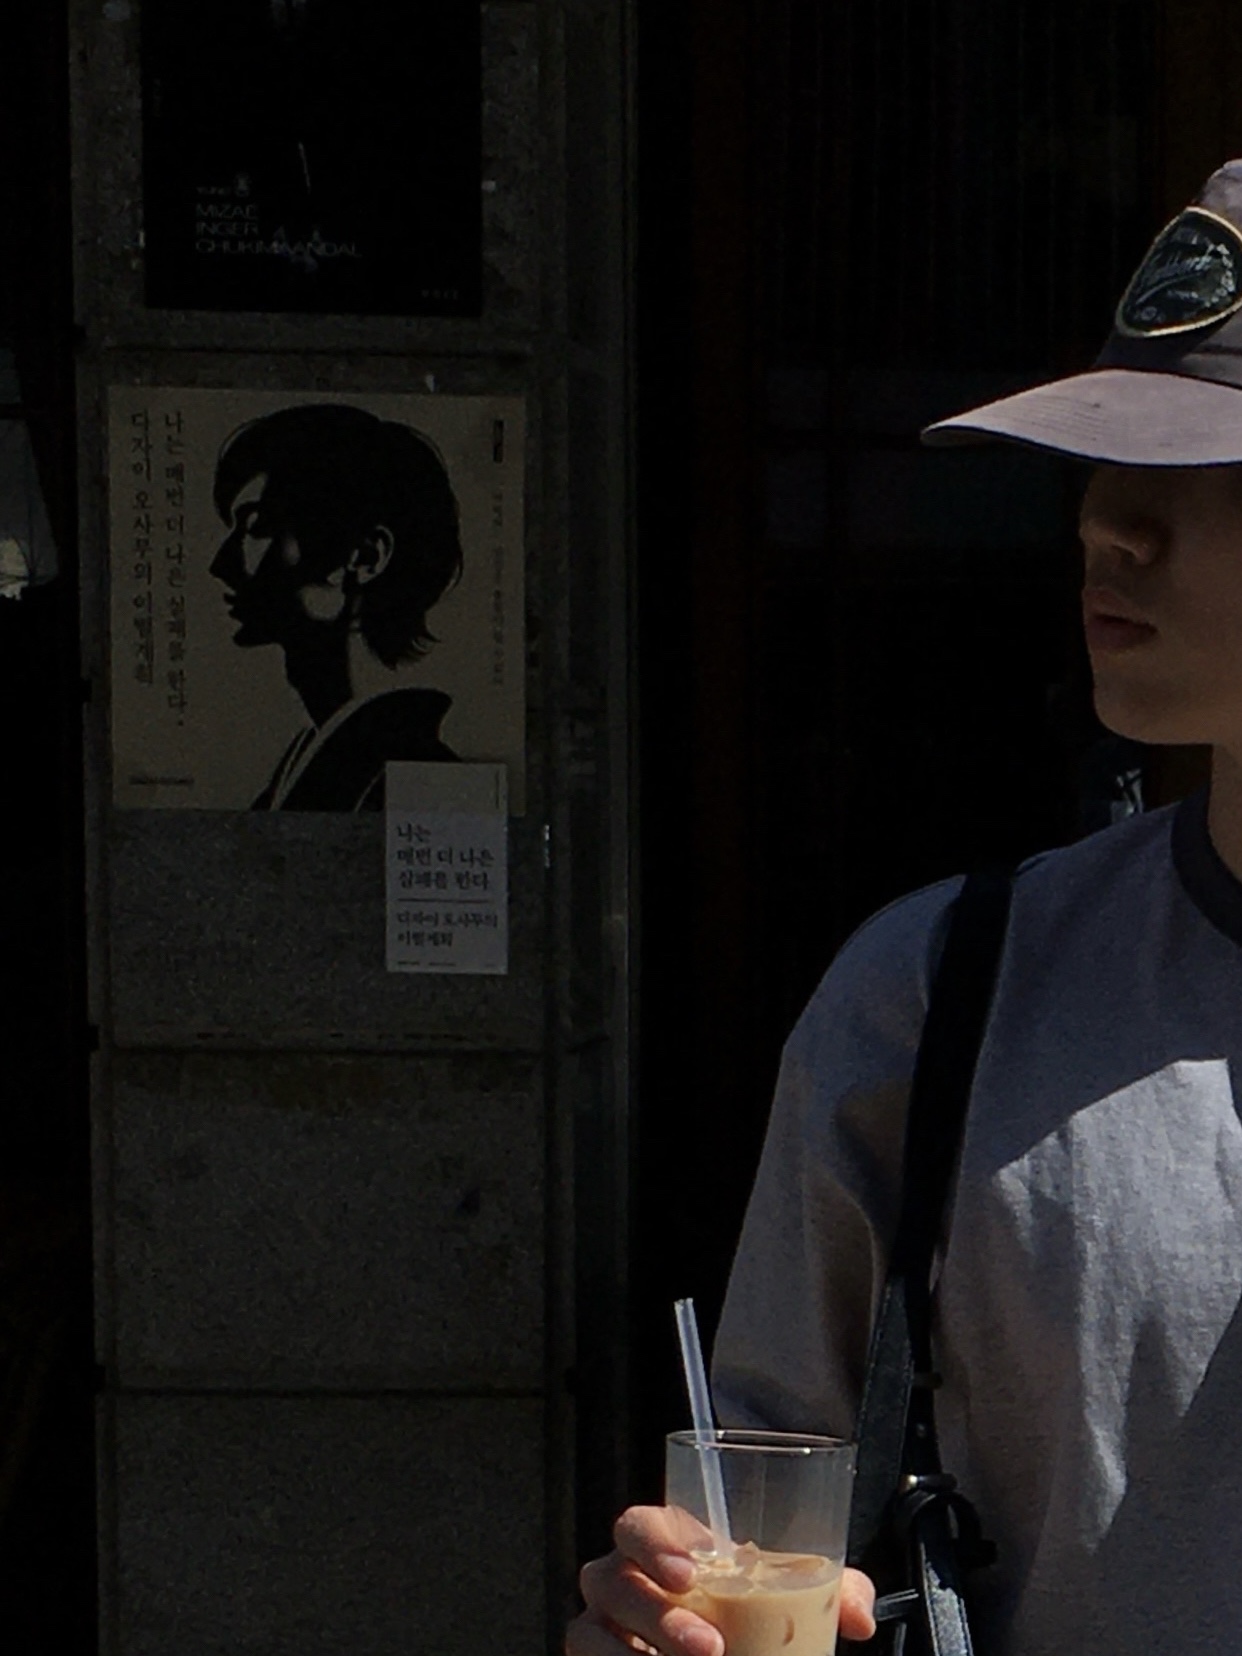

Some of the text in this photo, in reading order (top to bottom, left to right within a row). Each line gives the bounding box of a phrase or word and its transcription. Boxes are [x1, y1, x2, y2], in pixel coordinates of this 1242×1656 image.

[131, 408, 152, 482] 다자이
[165, 410, 184, 455] 나는
[165, 462, 184, 508] 매번
[132, 490, 153, 585] 오사무의
[167, 515, 184, 535] 더
[166, 542, 186, 588] 나은
[166, 595, 187, 661] 실패를
[397, 823, 431, 842] 나는
[397, 847, 495, 867] 매번 더 나은
[398, 869, 447, 889] 실패를
